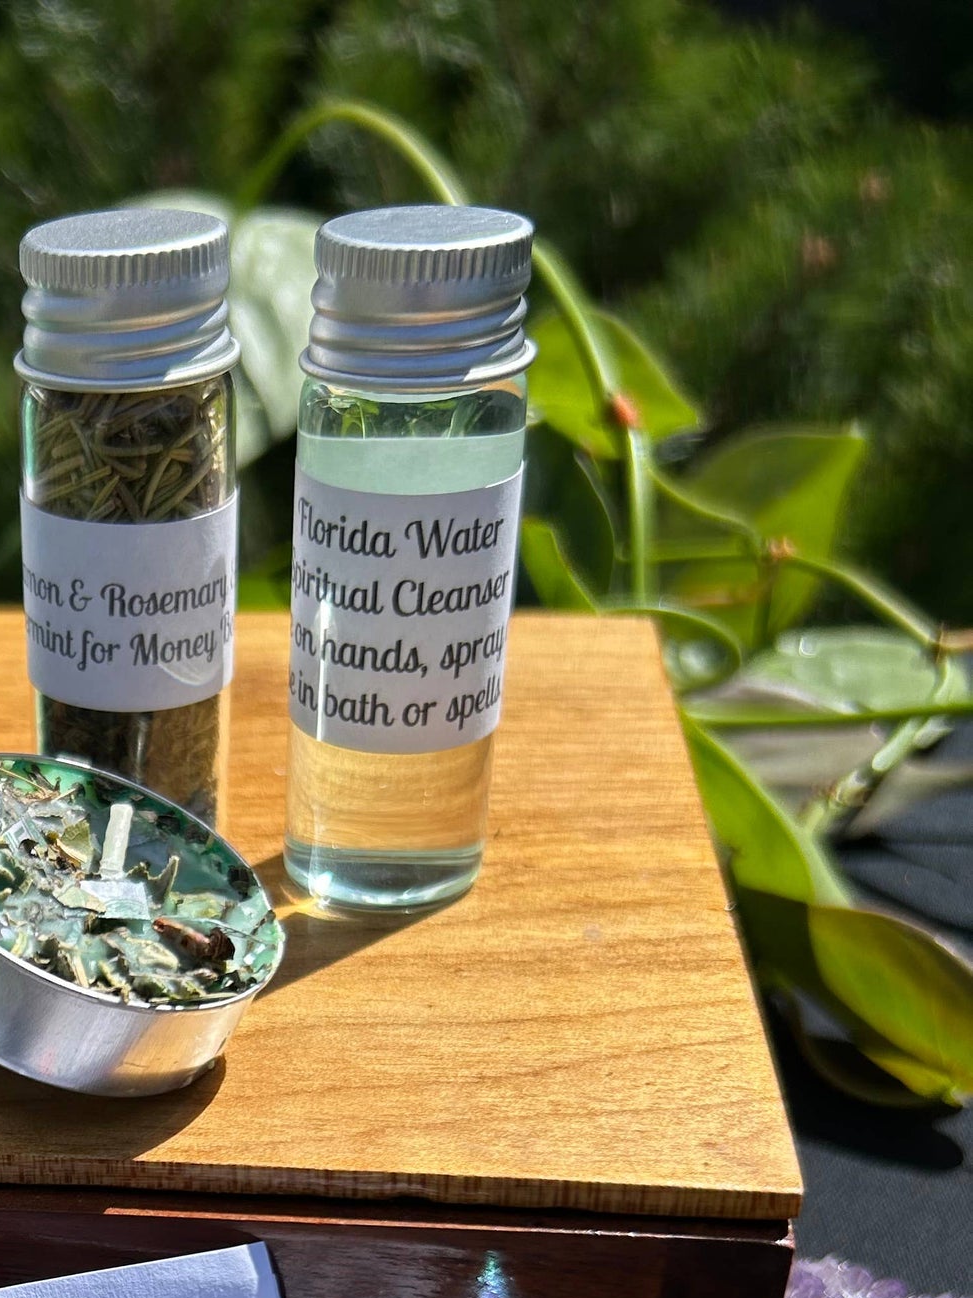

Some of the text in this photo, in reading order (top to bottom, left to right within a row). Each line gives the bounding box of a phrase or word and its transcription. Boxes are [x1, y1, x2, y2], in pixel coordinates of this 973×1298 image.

[298, 497, 505, 558] Florida Water
[69, 579, 92, 612] &
[100, 574, 227, 618] Rosemary
[392, 570, 509, 617] Cleanser
[77, 630, 120, 672] for
[130, 629, 217, 666] Money
[295, 622, 316, 656] on
[322, 629, 428, 678] hands,
[299, 670, 318, 711] in
[325, 684, 395, 727] bath
[402, 700, 437, 727] or
